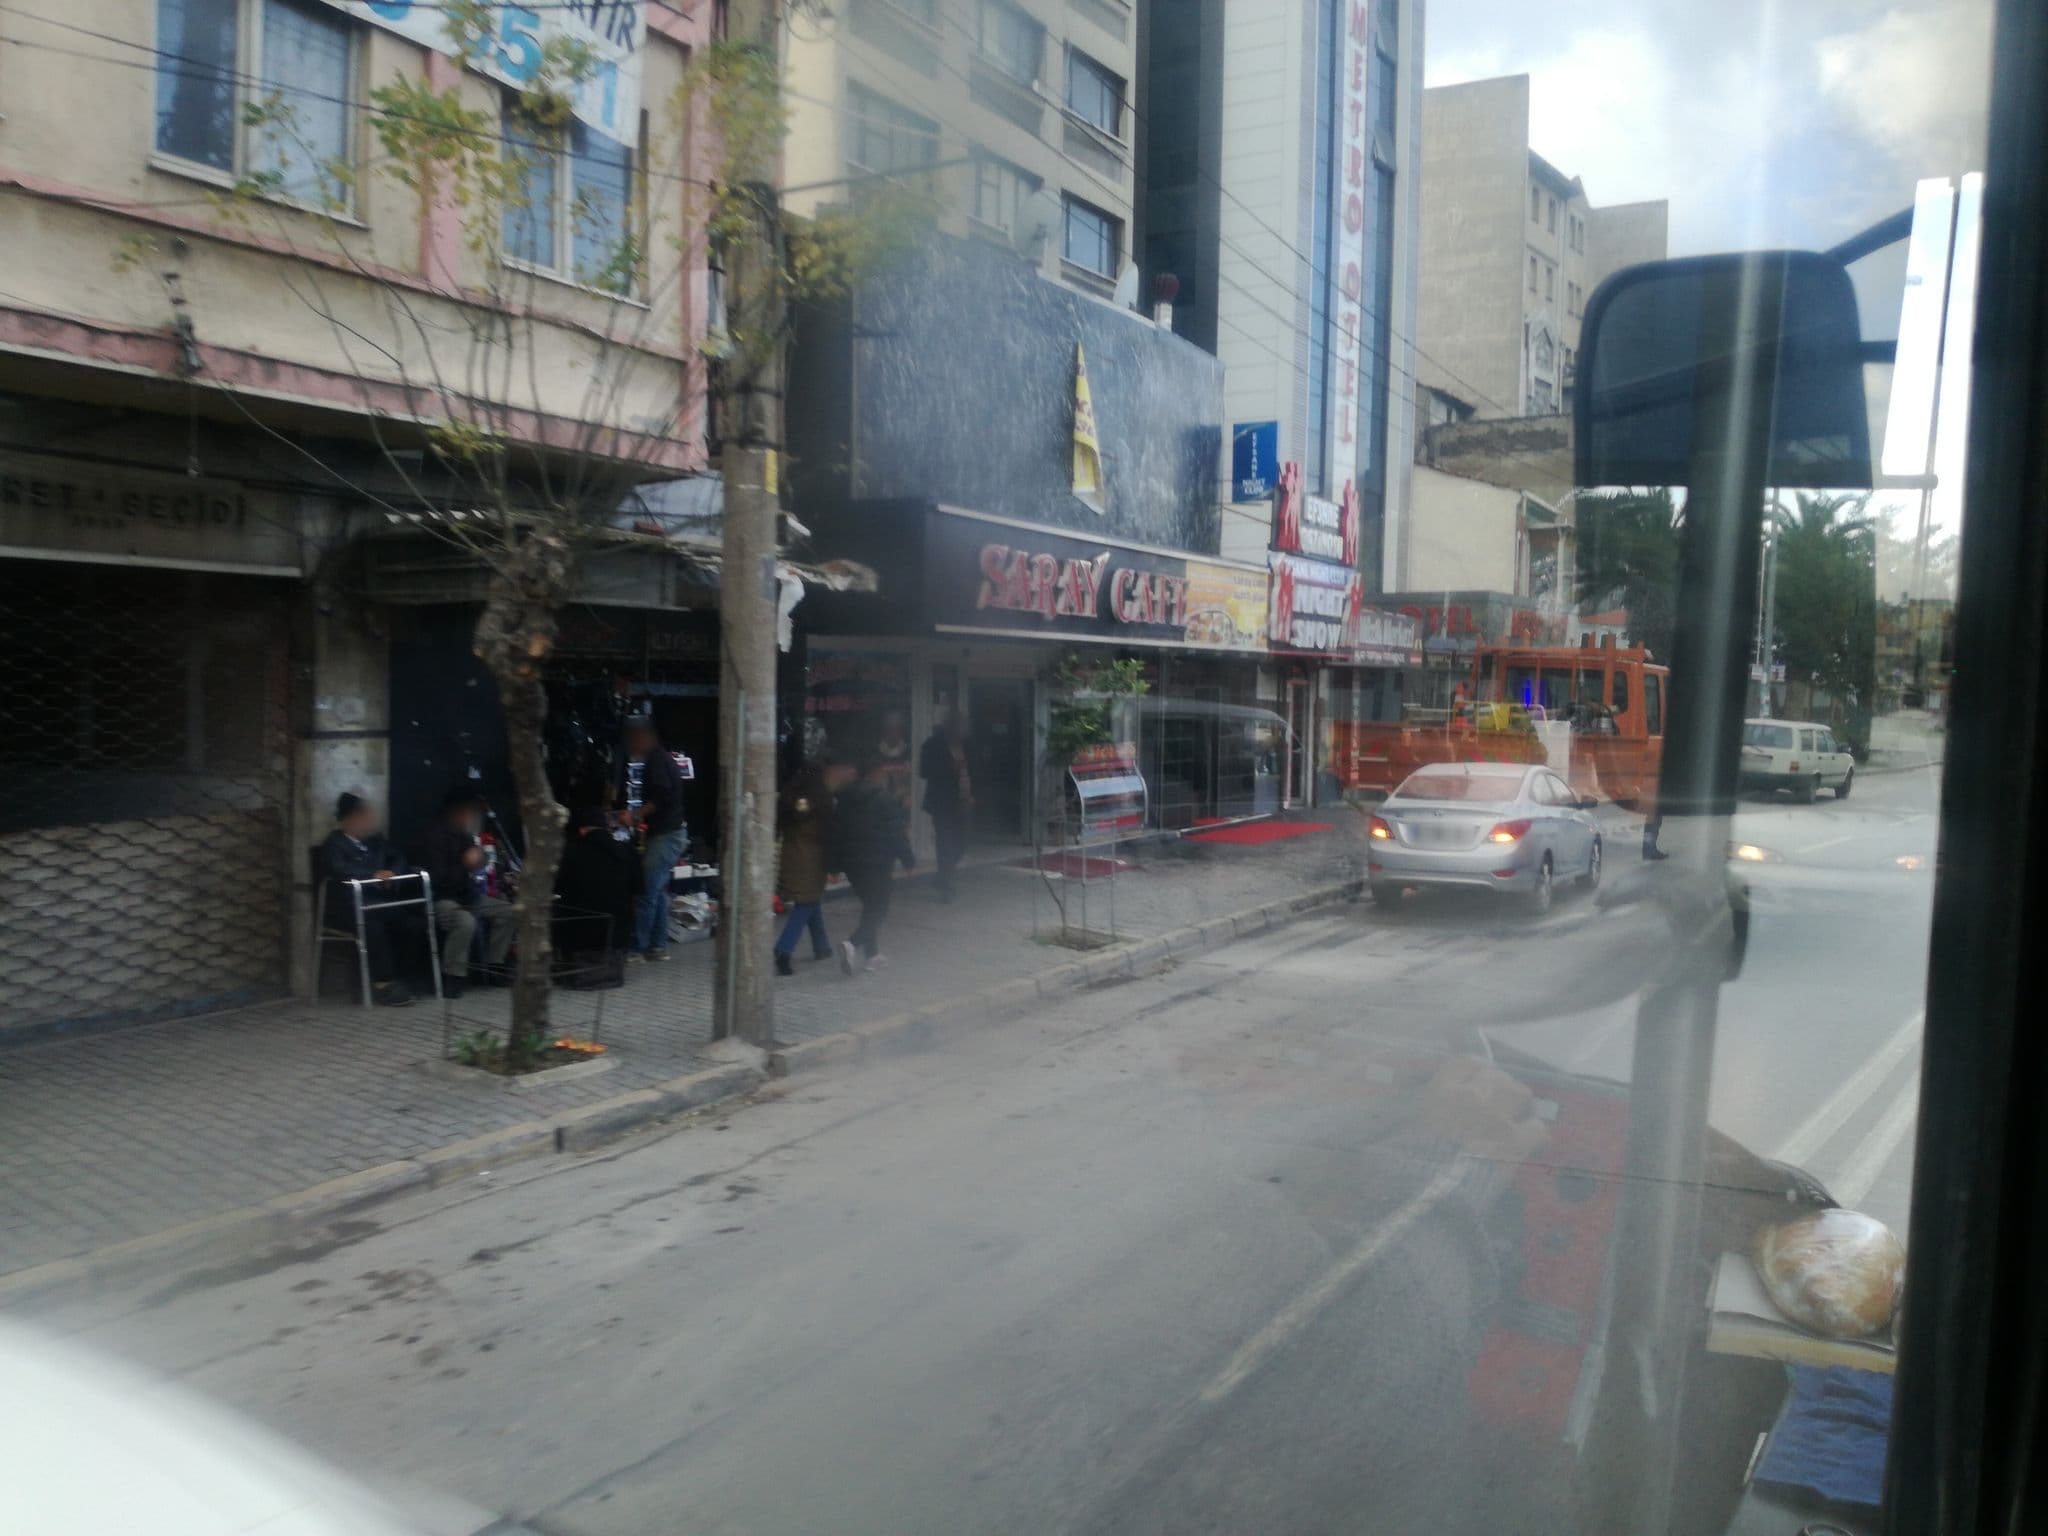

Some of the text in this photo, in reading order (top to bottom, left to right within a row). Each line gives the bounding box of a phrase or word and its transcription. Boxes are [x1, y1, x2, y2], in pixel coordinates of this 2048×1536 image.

[1342, 1, 1367, 443] METRO OTEL
[977, 543, 1110, 619] SARAY
[1293, 585, 1345, 617] NIGHT
[1291, 619, 1341, 649] SHOW
